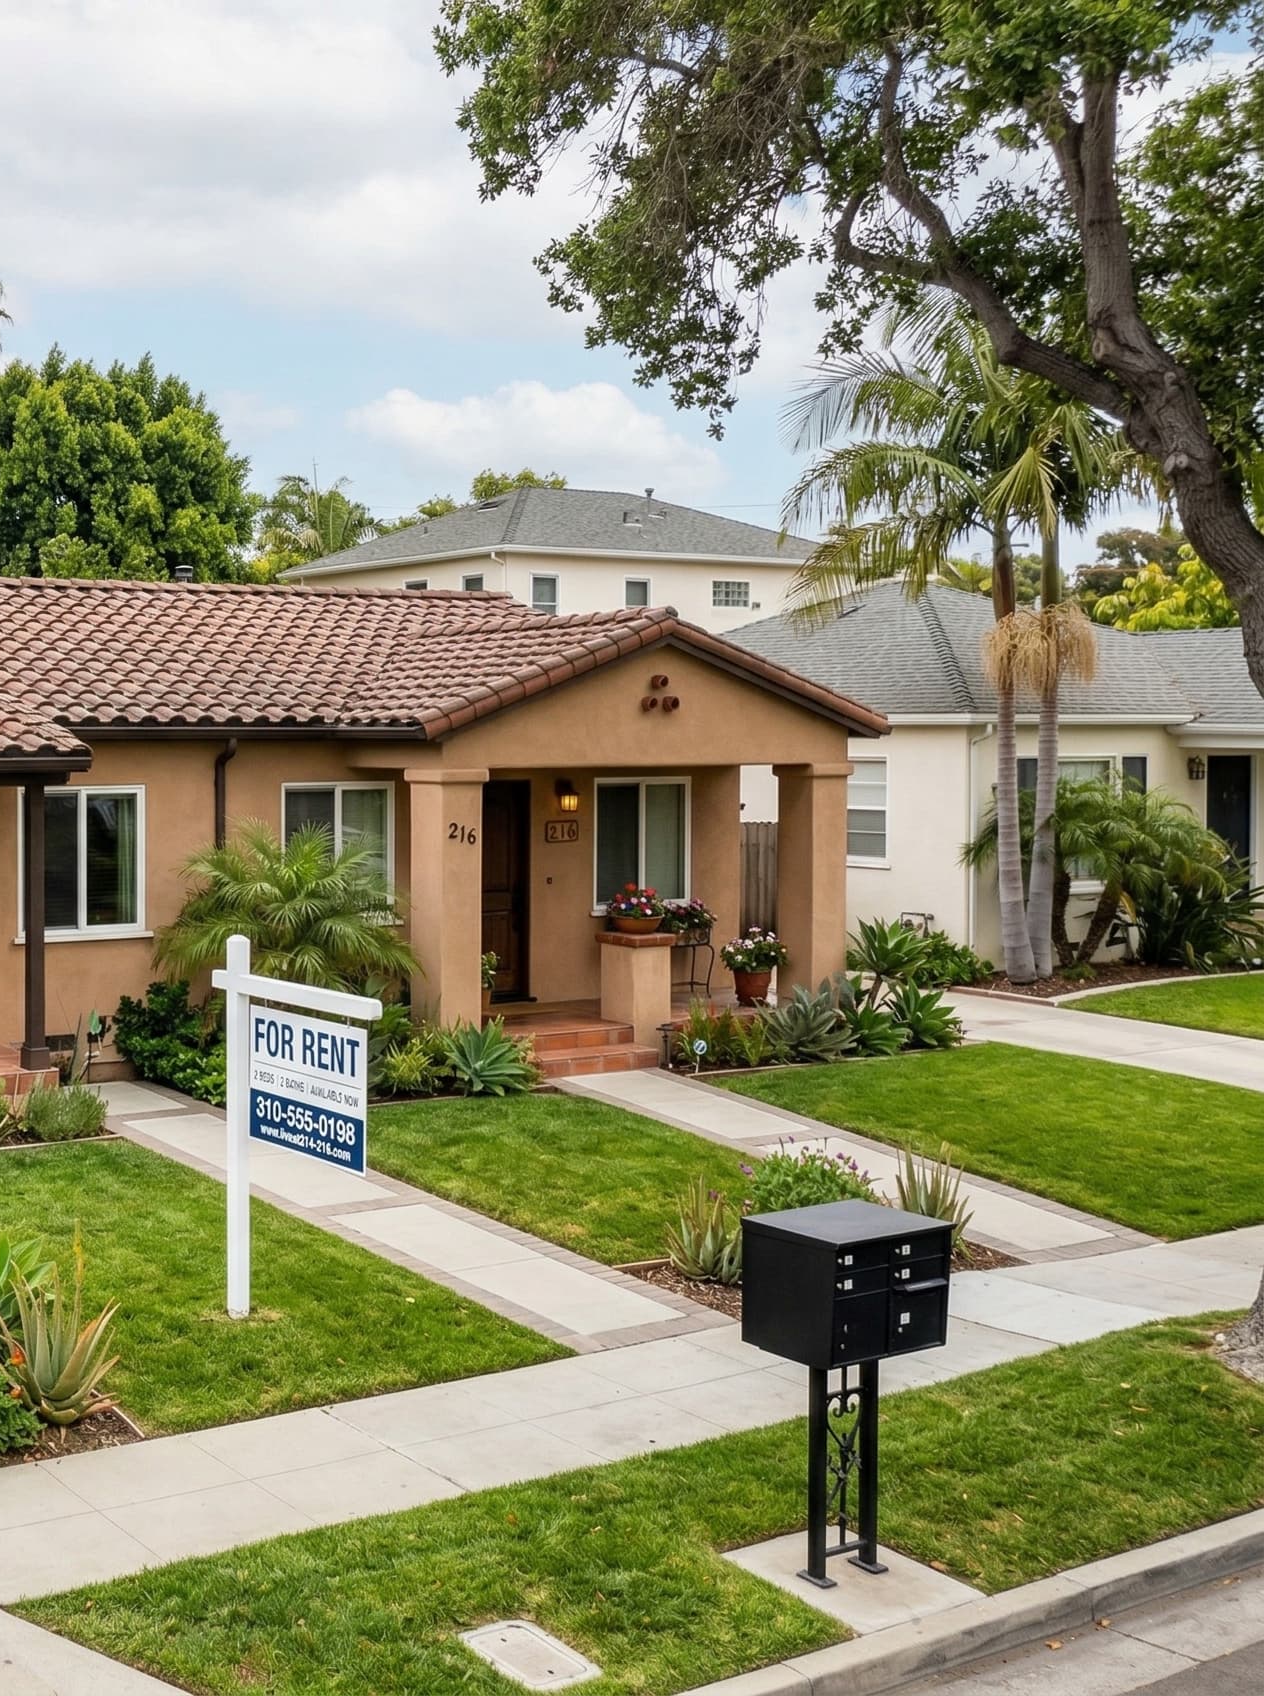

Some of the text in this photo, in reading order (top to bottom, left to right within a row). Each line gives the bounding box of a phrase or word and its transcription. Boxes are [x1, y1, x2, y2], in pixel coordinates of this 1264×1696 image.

[448, 822, 477, 845] 216
[549, 823, 576, 840] 216
[255, 1017, 360, 1077] FOR RENT
[256, 1096, 356, 1146] 310-555-0198
